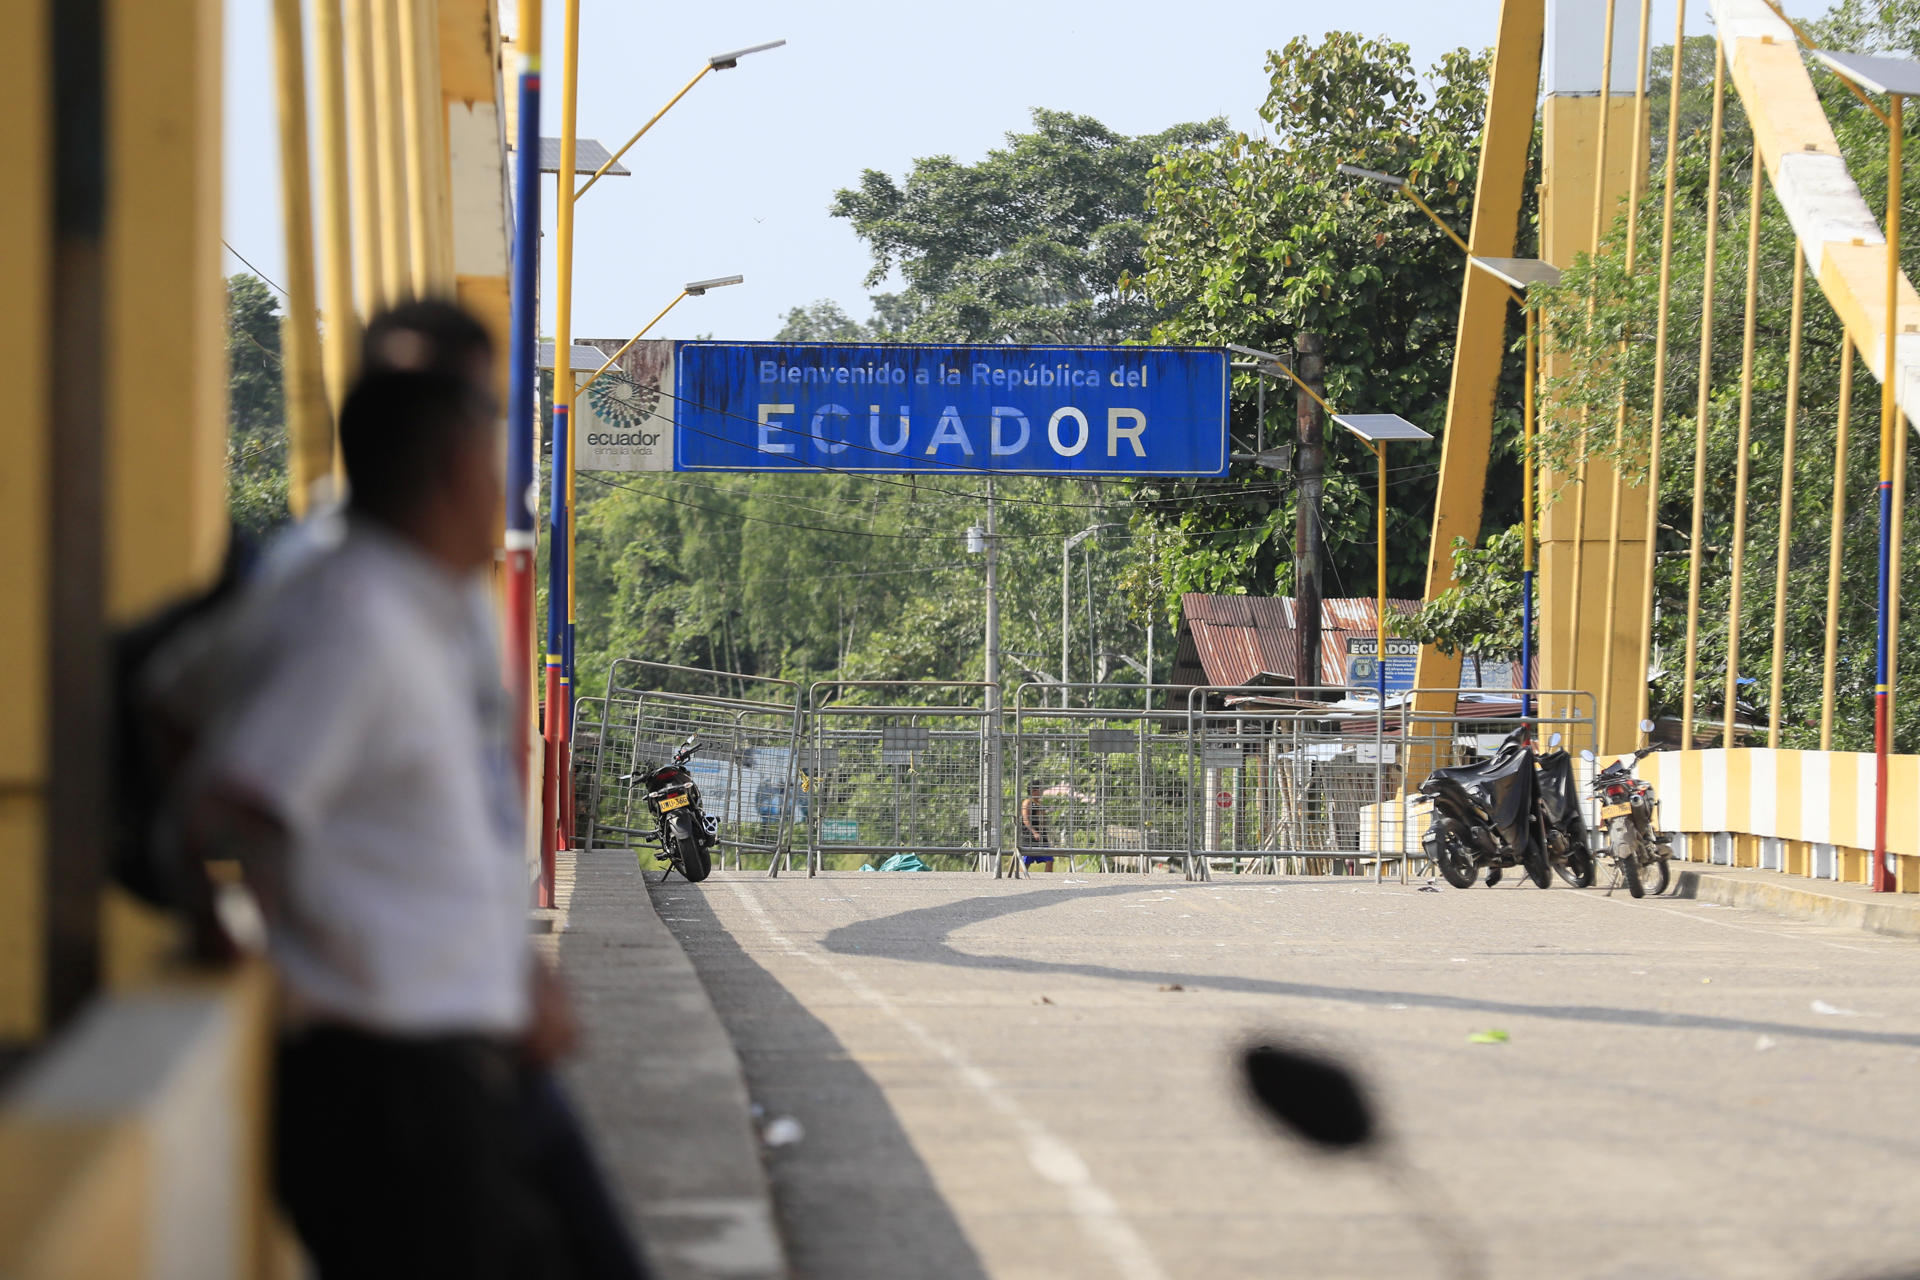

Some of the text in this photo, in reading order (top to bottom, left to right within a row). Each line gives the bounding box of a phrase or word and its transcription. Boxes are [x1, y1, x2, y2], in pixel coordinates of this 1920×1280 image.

[759, 360, 1148, 391] Bienvenido a la República del
[587, 430, 661, 446] ecuador
[757, 403, 1147, 457] ECUADOR
[631, 446, 653, 456] vida
